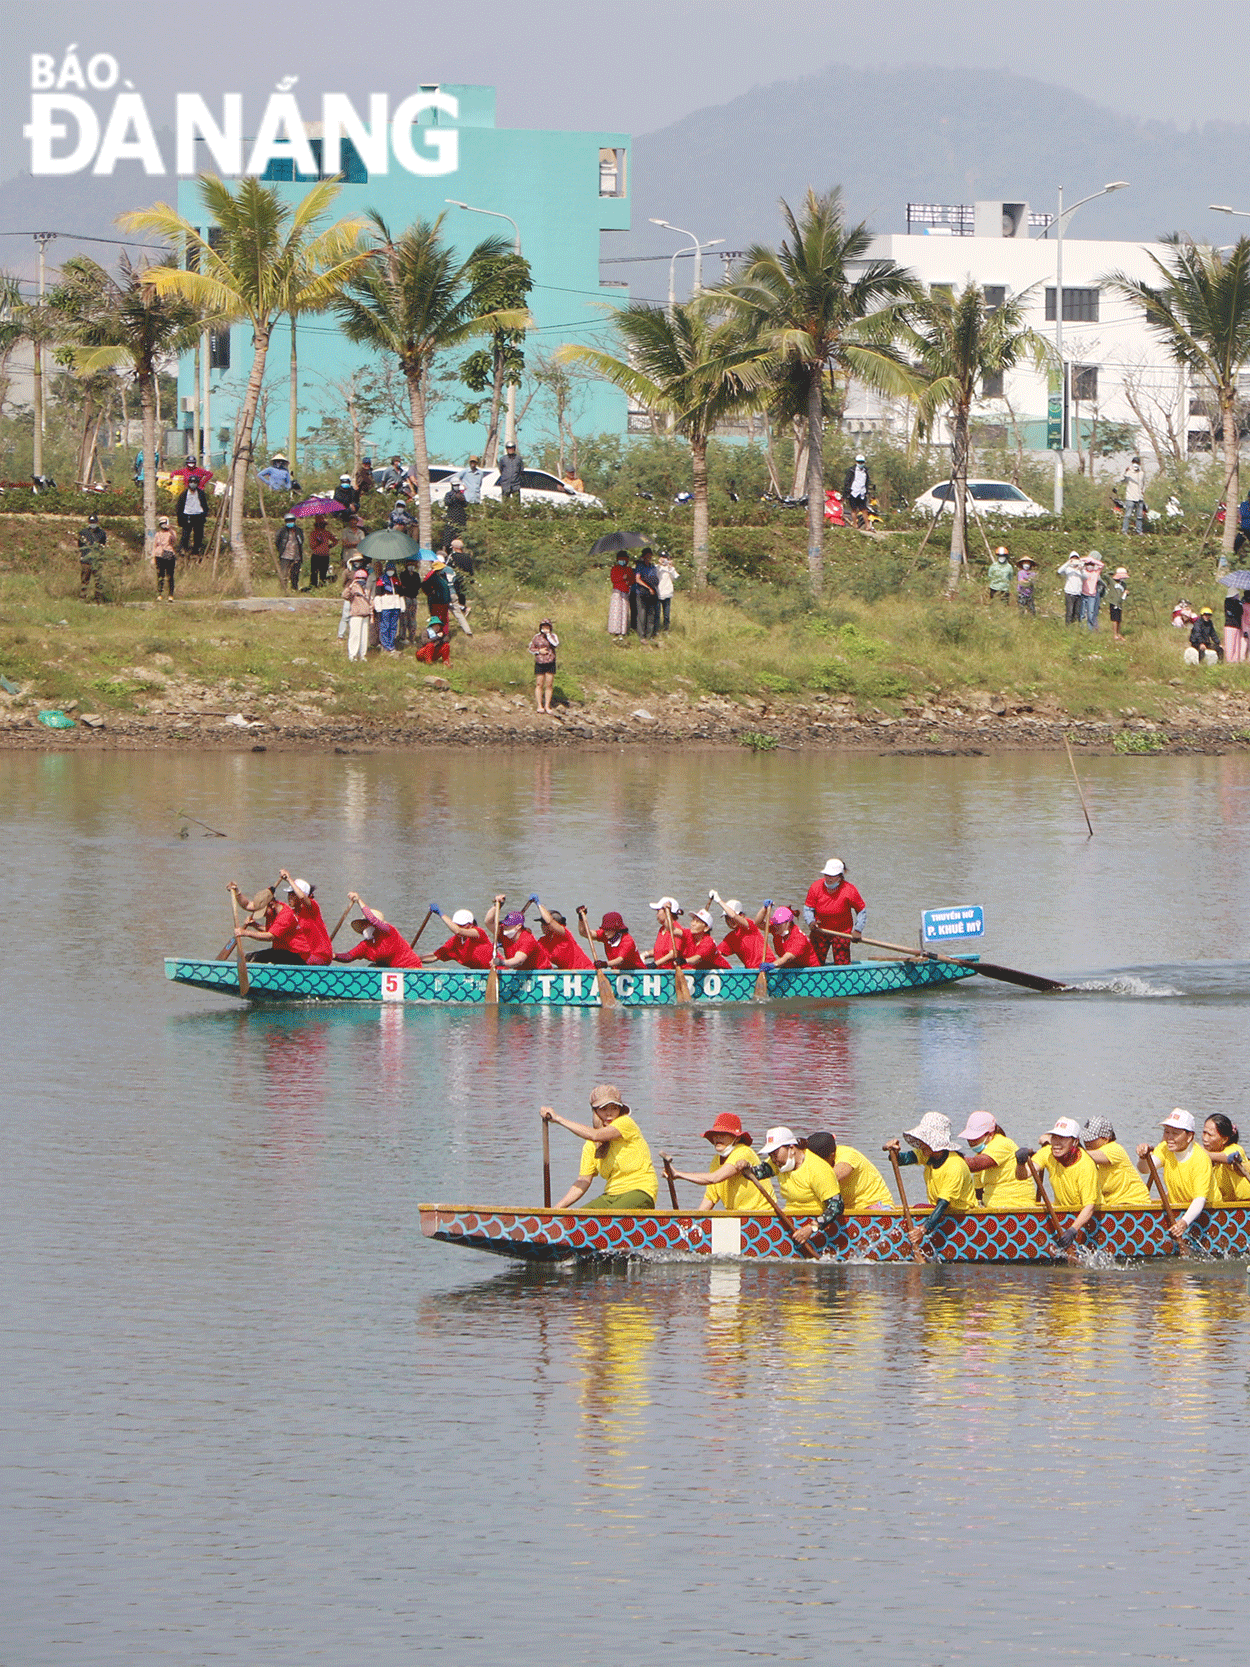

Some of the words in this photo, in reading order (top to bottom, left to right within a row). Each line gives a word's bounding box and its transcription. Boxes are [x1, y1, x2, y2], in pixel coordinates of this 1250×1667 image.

[927, 926, 937, 936] P.
[938, 921, 965, 935] KHUÊ
[966, 919, 982, 933] MỸ
[386, 975, 397, 992] 5
